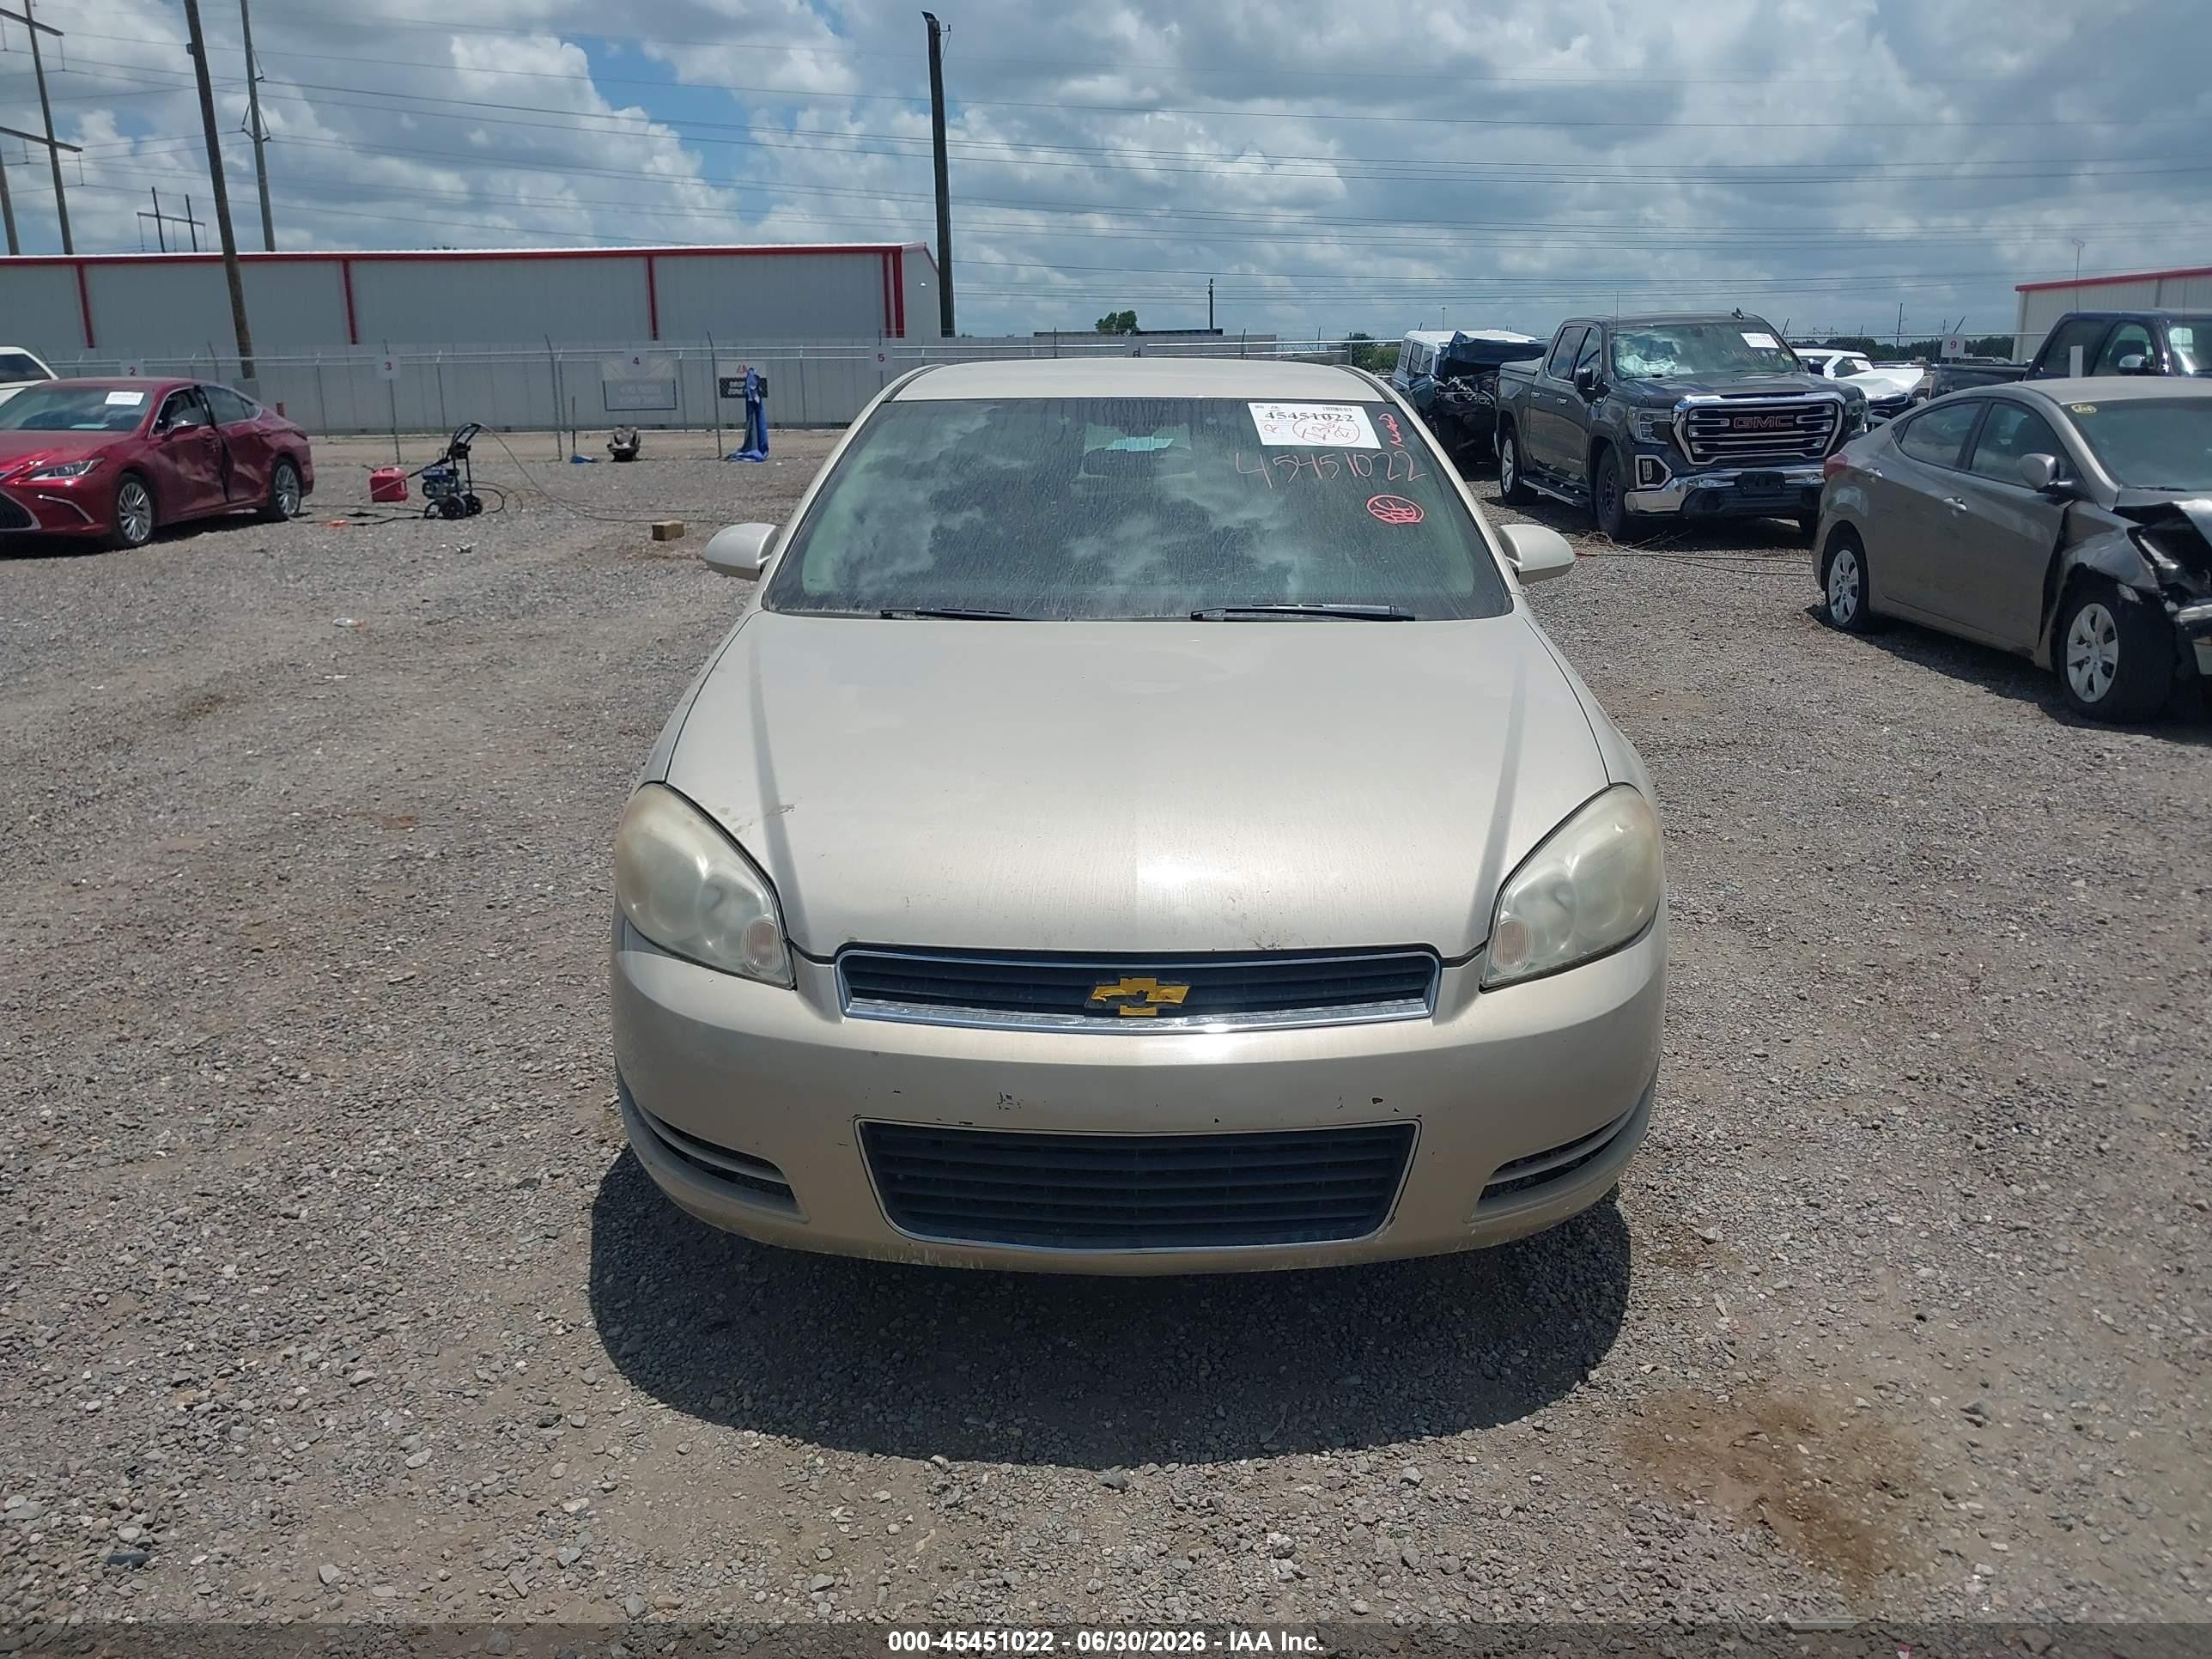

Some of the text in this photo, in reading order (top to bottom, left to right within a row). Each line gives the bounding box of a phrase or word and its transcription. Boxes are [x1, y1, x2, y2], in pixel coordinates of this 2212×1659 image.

[1950, 340, 1958, 349] 9
[384, 361, 392, 371] 3
[1265, 411, 1355, 422] 45451022
[1733, 415, 1795, 429] GMC
[1236, 450, 1427, 489] 45451022
